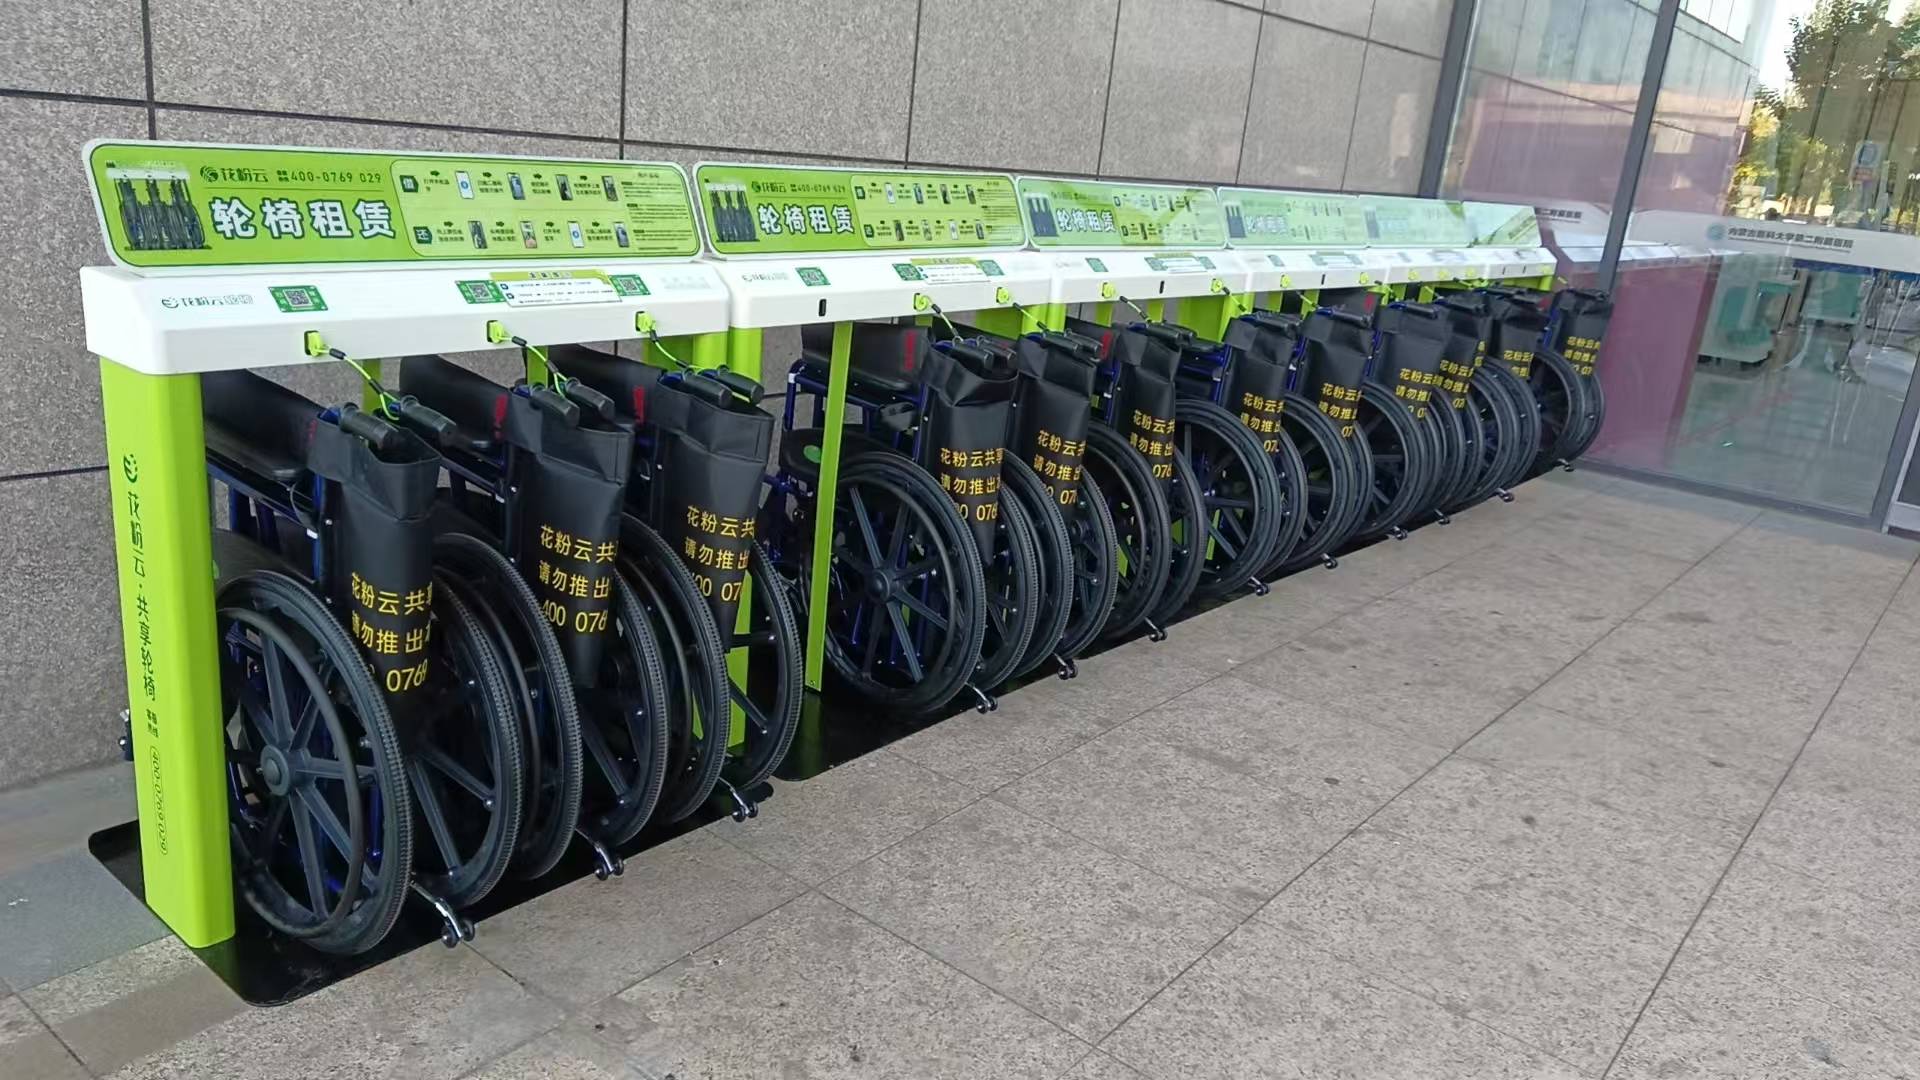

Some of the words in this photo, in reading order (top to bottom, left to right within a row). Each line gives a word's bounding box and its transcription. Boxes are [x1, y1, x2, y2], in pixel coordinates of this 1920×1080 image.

[219, 167, 269, 183] 花粉云
[291, 171, 353, 183] 400-0769
[360, 172, 382, 184] 029
[209, 196, 396, 240] 轮椅租赁
[757, 203, 855, 235] 轮椅租赁
[1440, 359, 1474, 377] 花粉云
[1321, 382, 1361, 401] 花粉云
[1395, 385, 1432, 402] 请勿推
[1263, 439, 1280, 453] 07
[1060, 489, 1078, 505] 07
[687, 505, 756, 539] 花粉云共
[540, 523, 619, 564] 花粉云共
[684, 536, 751, 570] 请勿推出
[539, 560, 612, 599] 请勿推出
[691, 572, 713, 597] 00
